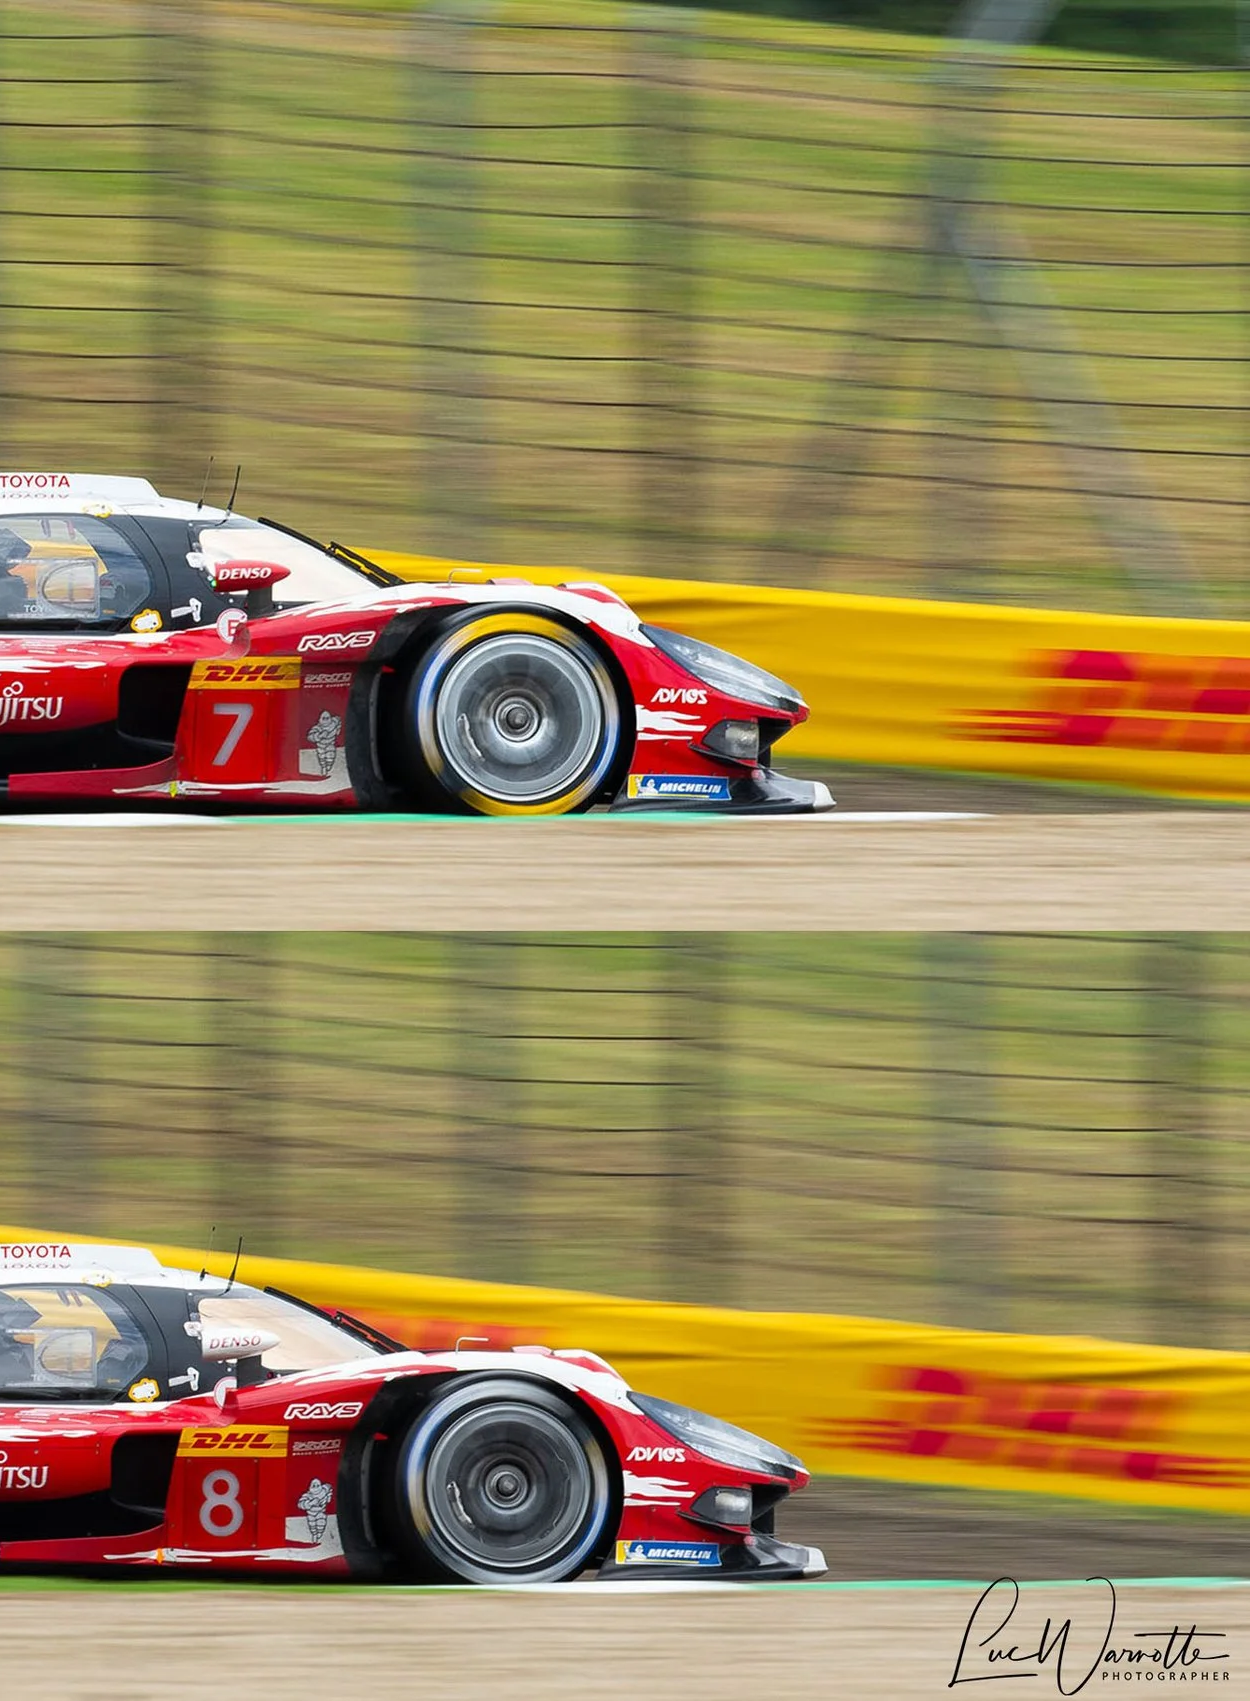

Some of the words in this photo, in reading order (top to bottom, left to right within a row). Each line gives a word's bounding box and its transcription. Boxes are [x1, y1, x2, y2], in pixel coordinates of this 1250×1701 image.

[0, 475, 71, 488] TOYOTA
[218, 567, 273, 581] DENSO
[297, 630, 377, 653] RAYS
[204, 664, 285, 682] DHL
[211, 702, 254, 767] 7
[658, 782, 722, 795] MICHELIN
[0, 1245, 71, 1259] TOYOTA
[209, 1335, 262, 1350] DENSO
[284, 1402, 363, 1420] RAYS
[191, 1432, 276, 1449] DHL
[199, 1468, 244, 1538] 8
[647, 1548, 712, 1560] MICHELIN
